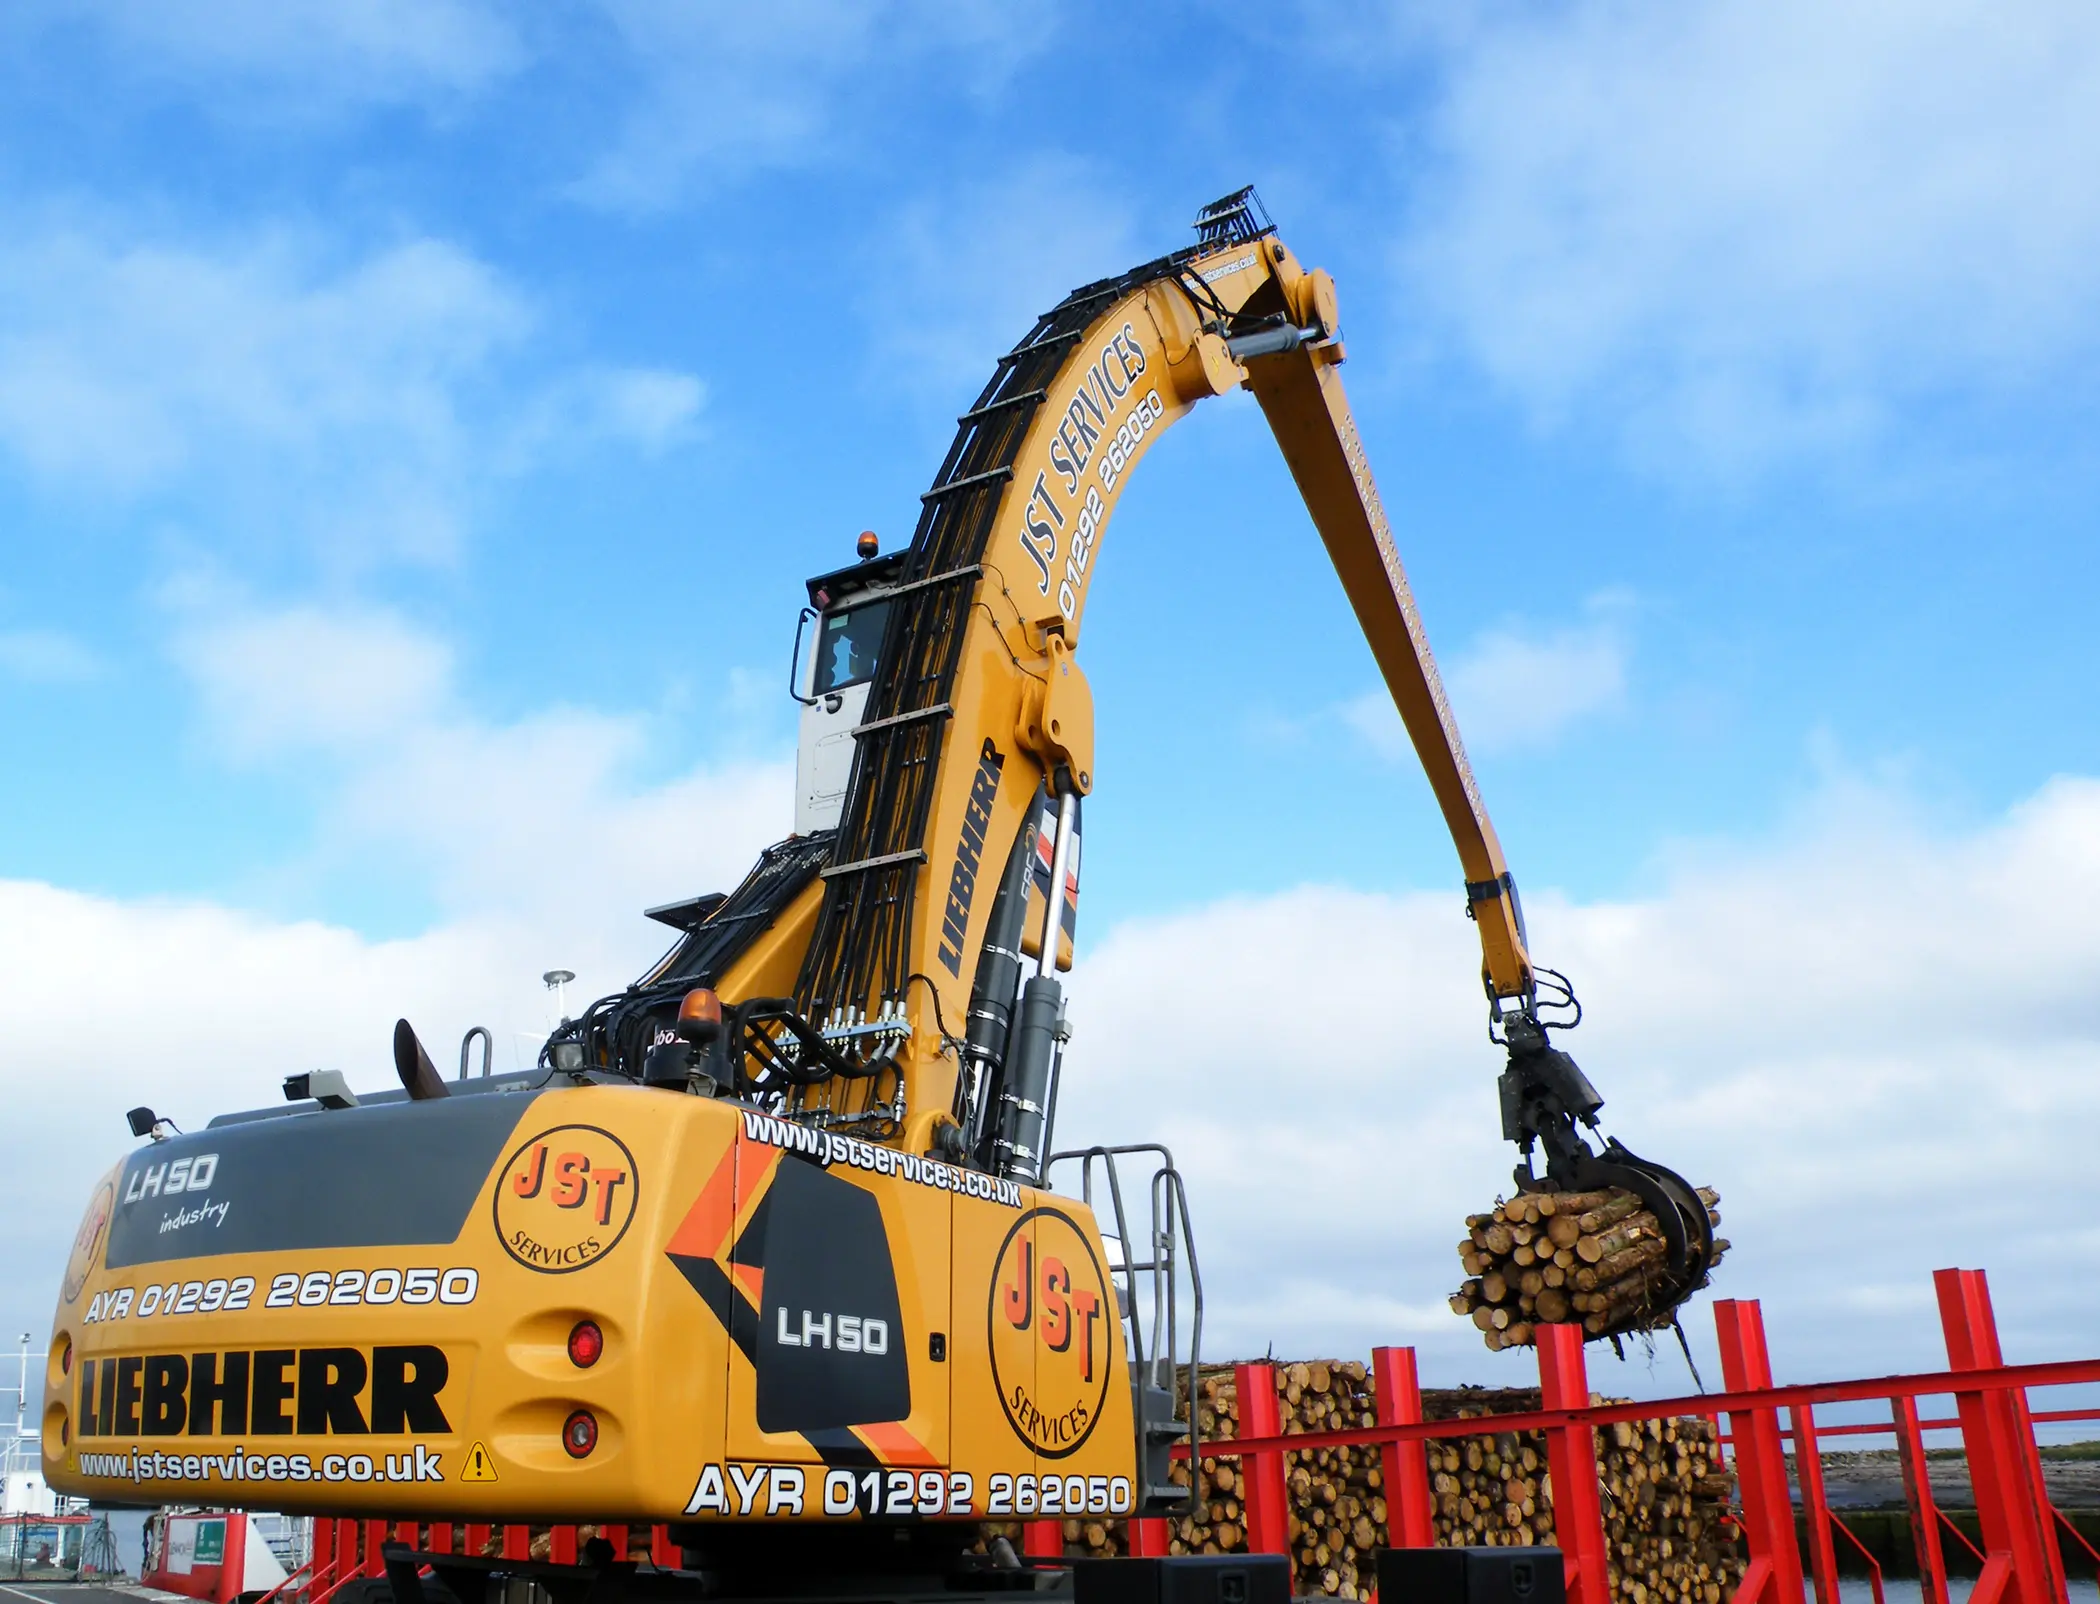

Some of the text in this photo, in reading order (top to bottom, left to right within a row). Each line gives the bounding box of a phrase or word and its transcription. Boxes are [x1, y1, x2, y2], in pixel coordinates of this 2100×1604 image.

[1019, 322, 1146, 596] JST SERVICES
[1057, 388, 1165, 620] 01292 262050
[938, 737, 1006, 979] LIEBHERR
[123, 1153, 220, 1204] LH50
[514, 1143, 626, 1226] JST
[742, 1110, 1023, 1208] www.jstservices.co.uk
[159, 1198, 230, 1234] industry
[510, 1229, 601, 1265] SERVICES
[83, 1287, 135, 1325] AYR
[136, 1275, 256, 1317] 01292
[264, 1267, 479, 1308] 262050
[1003, 1234, 1100, 1384] JST
[777, 1306, 889, 1355] LH50
[79, 1345, 453, 1436] LIEBHERR
[1009, 1385, 1089, 1444] SERVICES
[80, 1445, 444, 1484] www.jstservices.co.uk
[683, 1463, 1131, 1516] AYR 01292 262050
